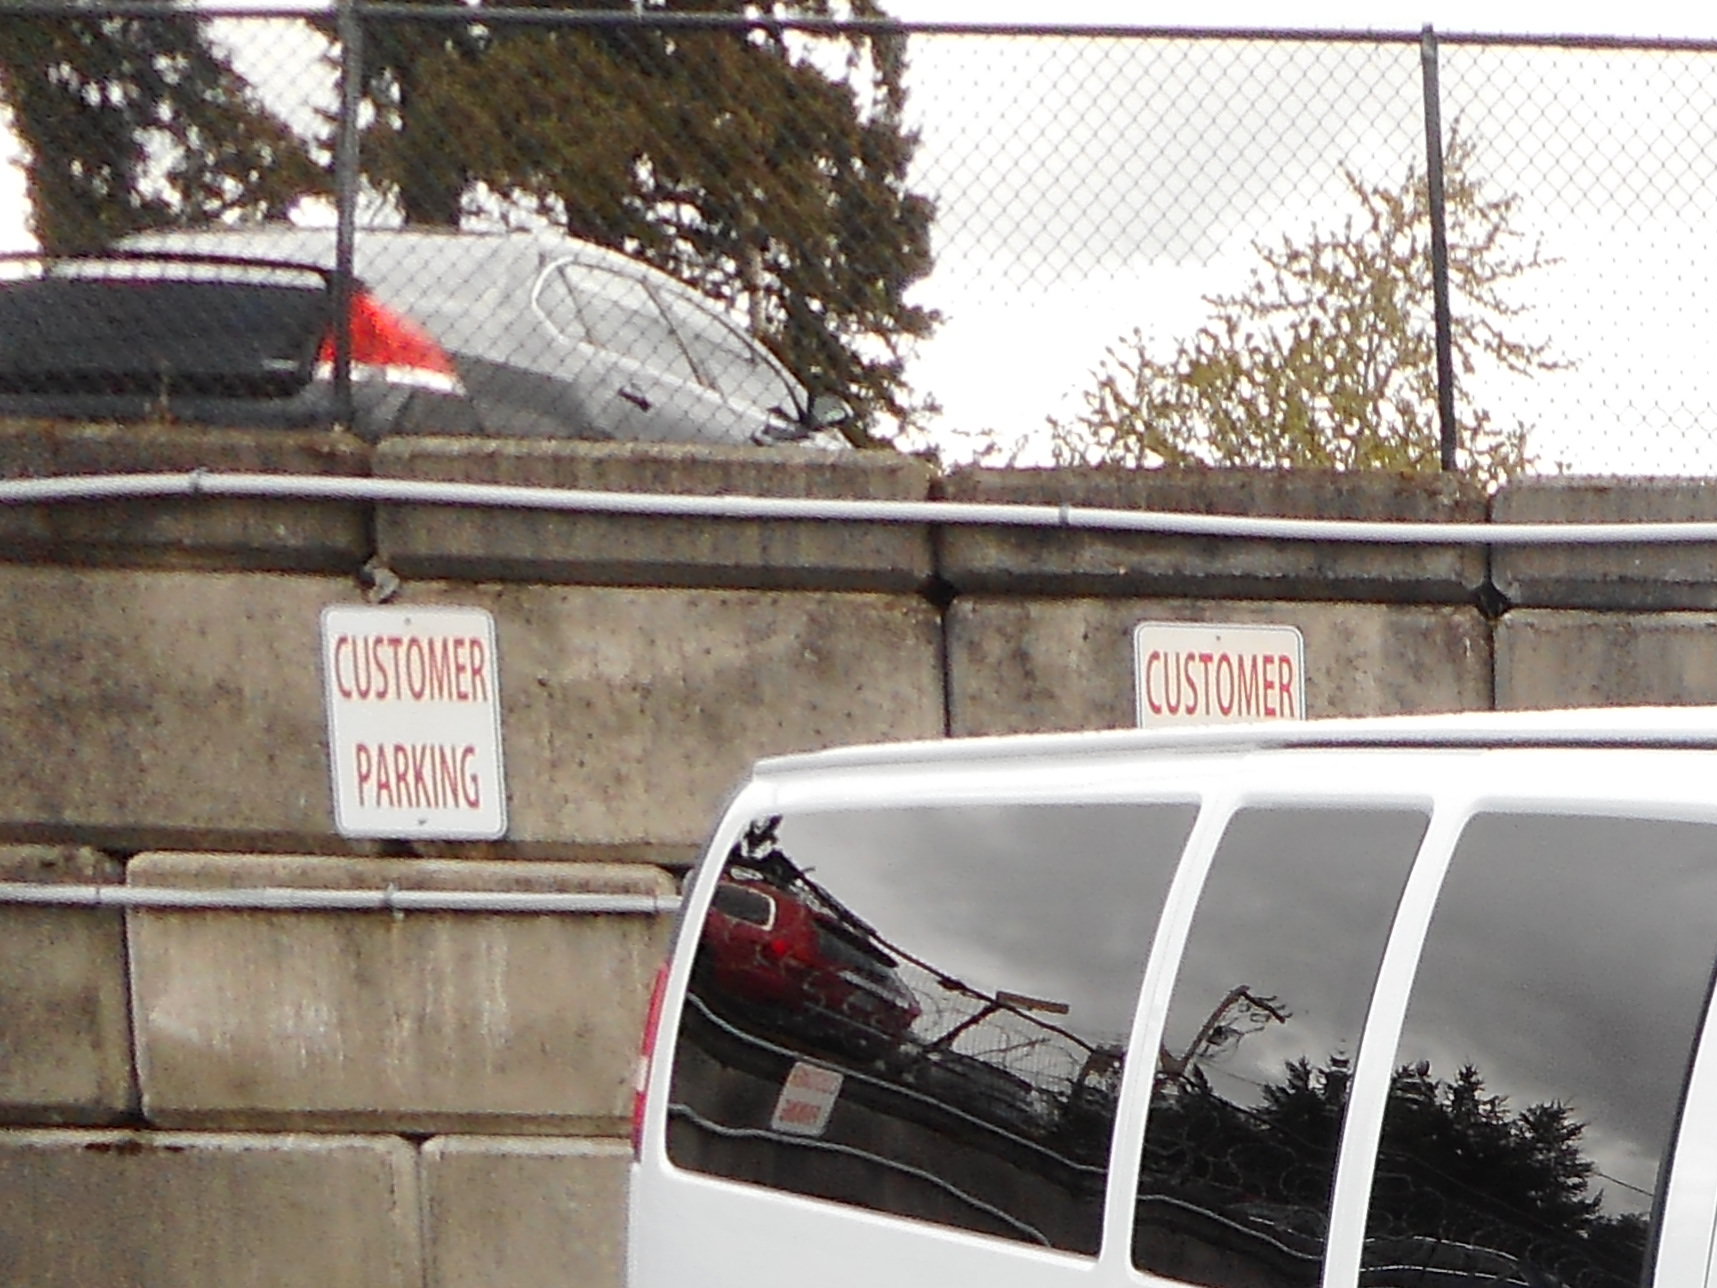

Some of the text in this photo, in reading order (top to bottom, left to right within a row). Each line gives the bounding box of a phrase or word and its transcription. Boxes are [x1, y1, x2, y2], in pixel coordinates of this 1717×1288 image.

[335, 635, 488, 701] CUSTOMER
[1146, 650, 1295, 718] CUSTOMER
[355, 742, 481, 809] PARKING
